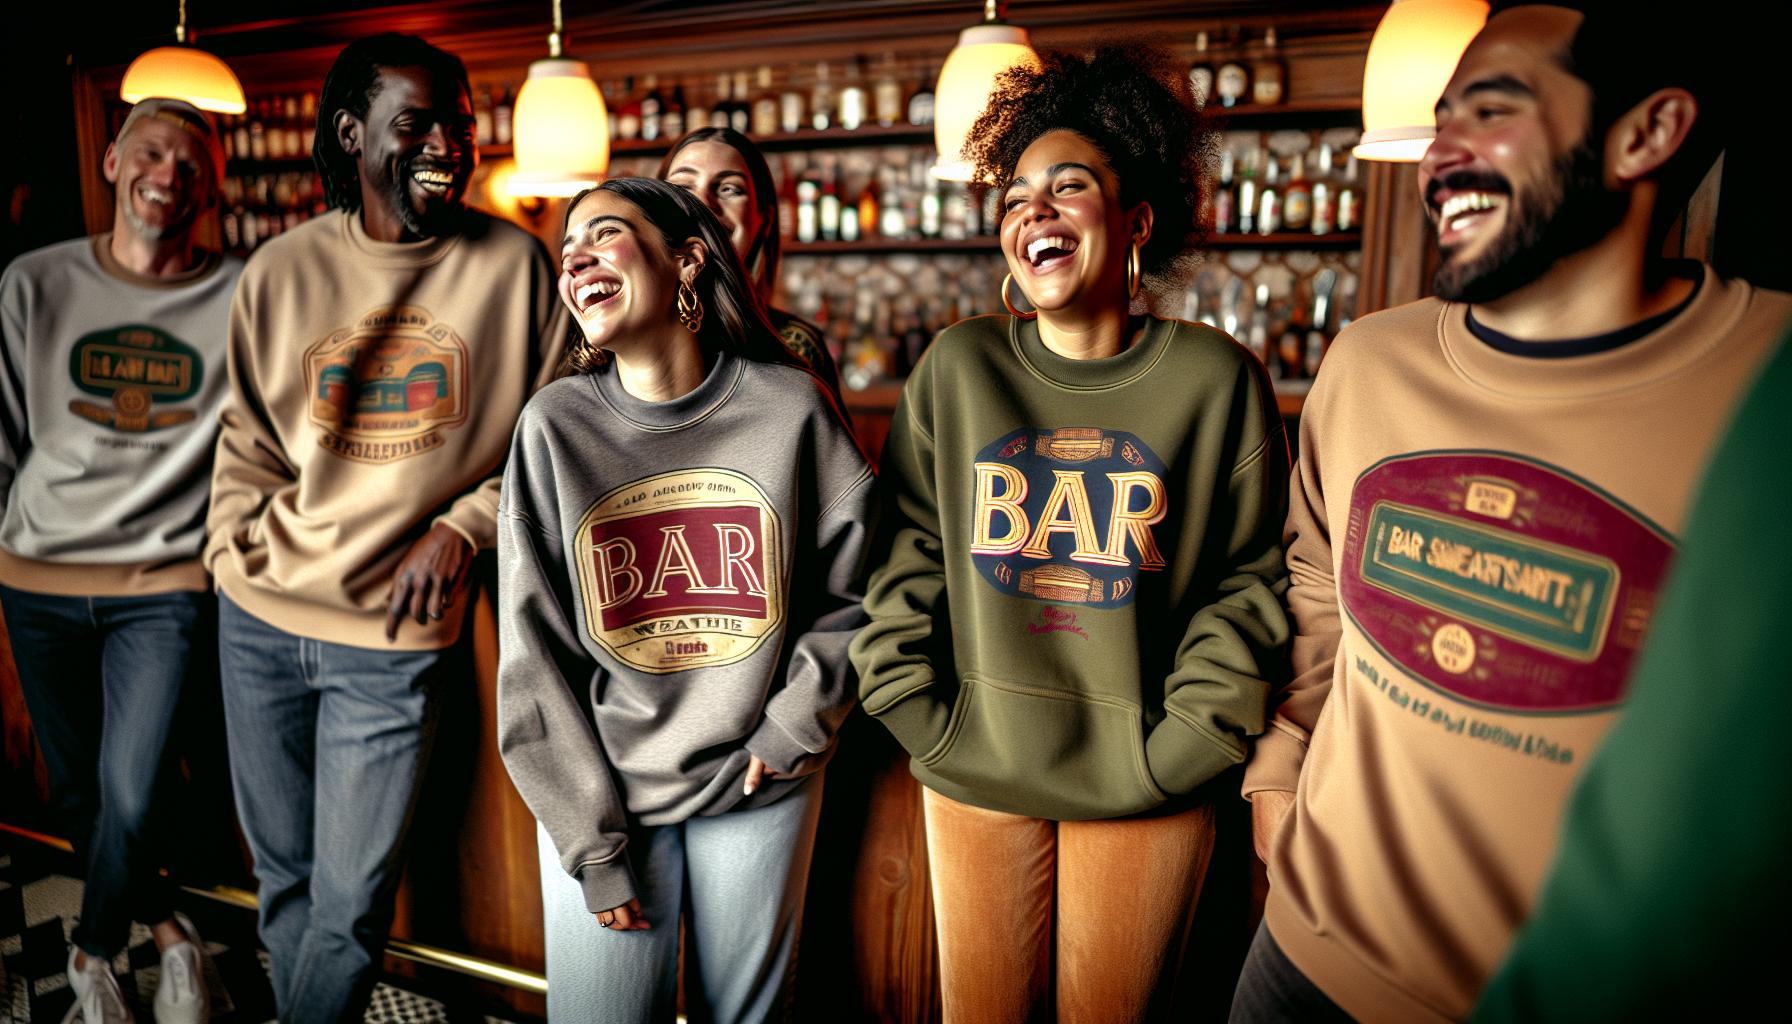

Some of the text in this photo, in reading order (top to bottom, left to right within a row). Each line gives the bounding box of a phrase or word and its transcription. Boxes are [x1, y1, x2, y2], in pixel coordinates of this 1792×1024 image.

[971, 462, 1167, 571] BAR
[1387, 525, 1425, 563] BAR
[593, 523, 768, 608] BAR
